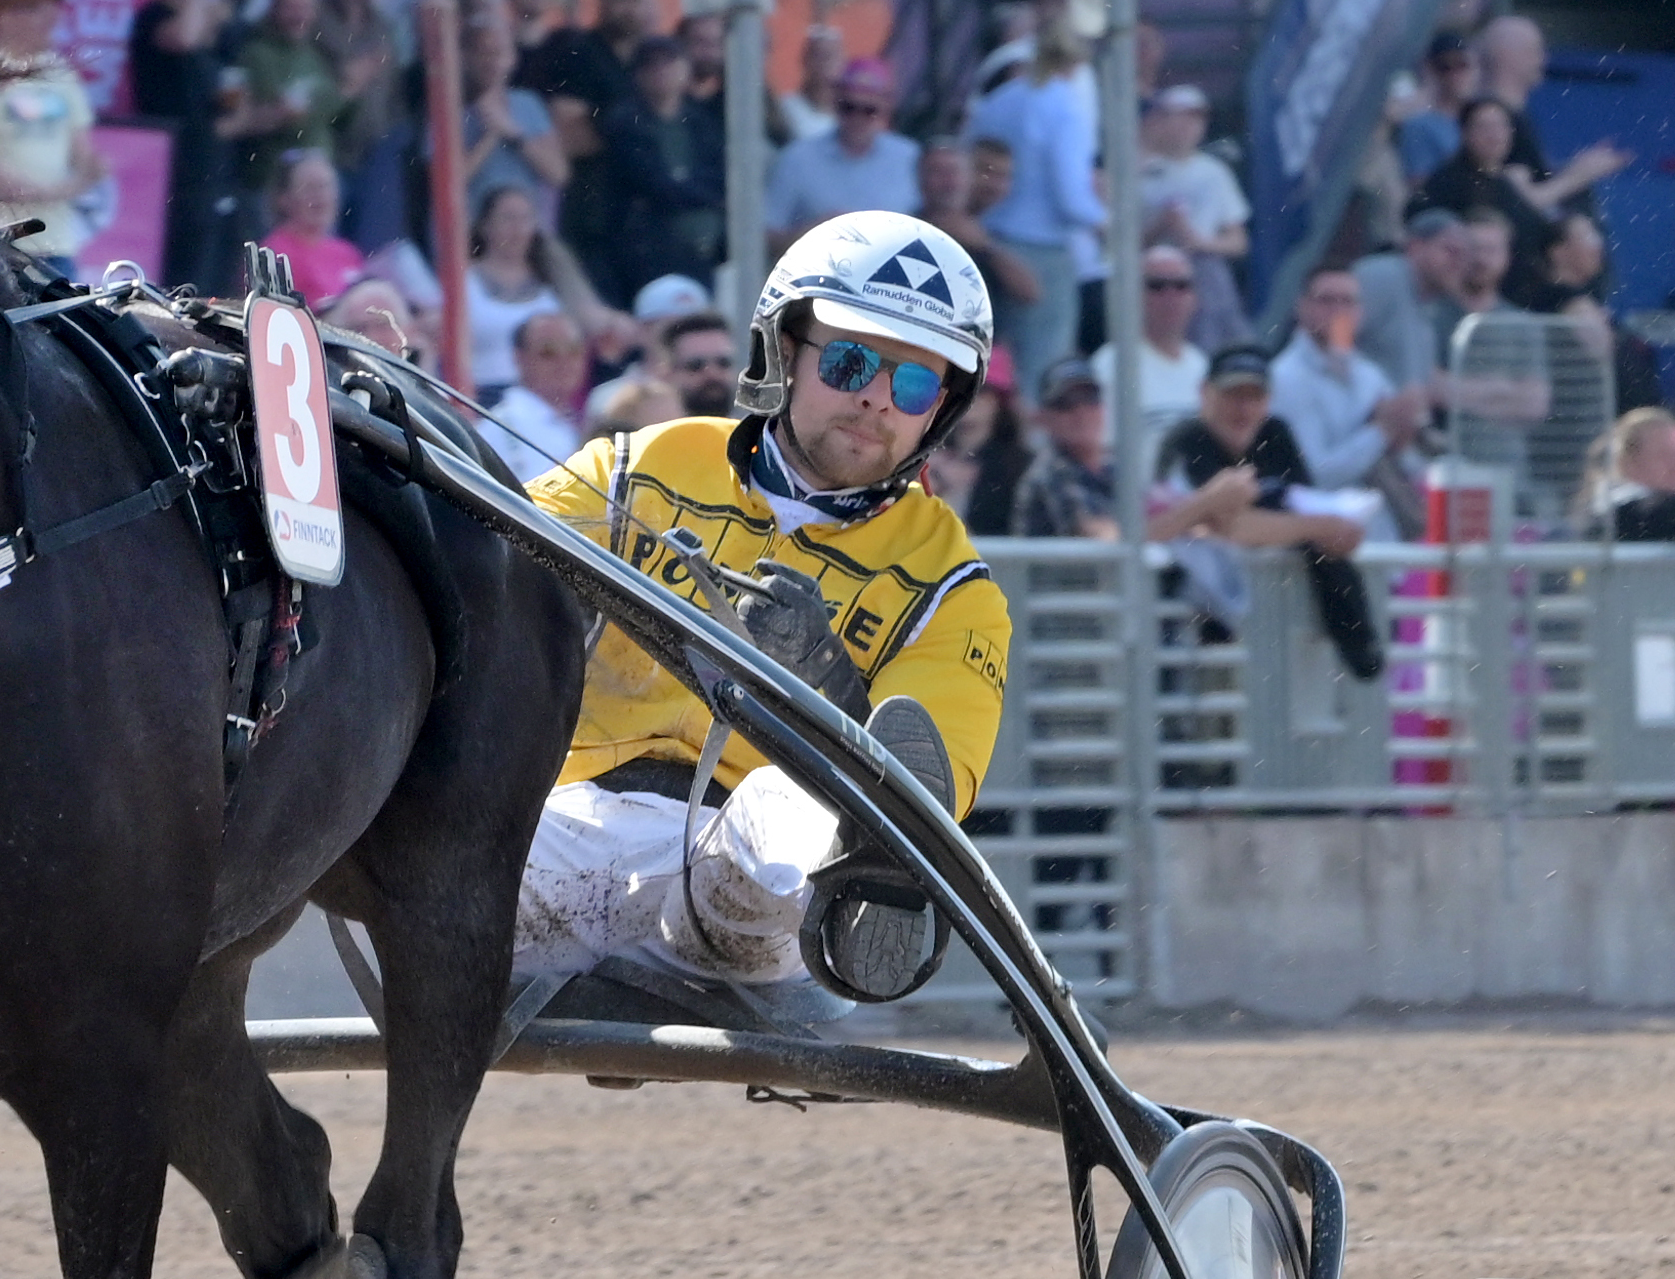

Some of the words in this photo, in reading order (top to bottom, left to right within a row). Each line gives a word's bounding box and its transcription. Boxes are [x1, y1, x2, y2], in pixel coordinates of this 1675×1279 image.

[862, 283, 923, 308] Ramudden
[924, 299, 955, 322] Global
[266, 307, 321, 505] 3
[292, 518, 338, 549] FINNTACK
